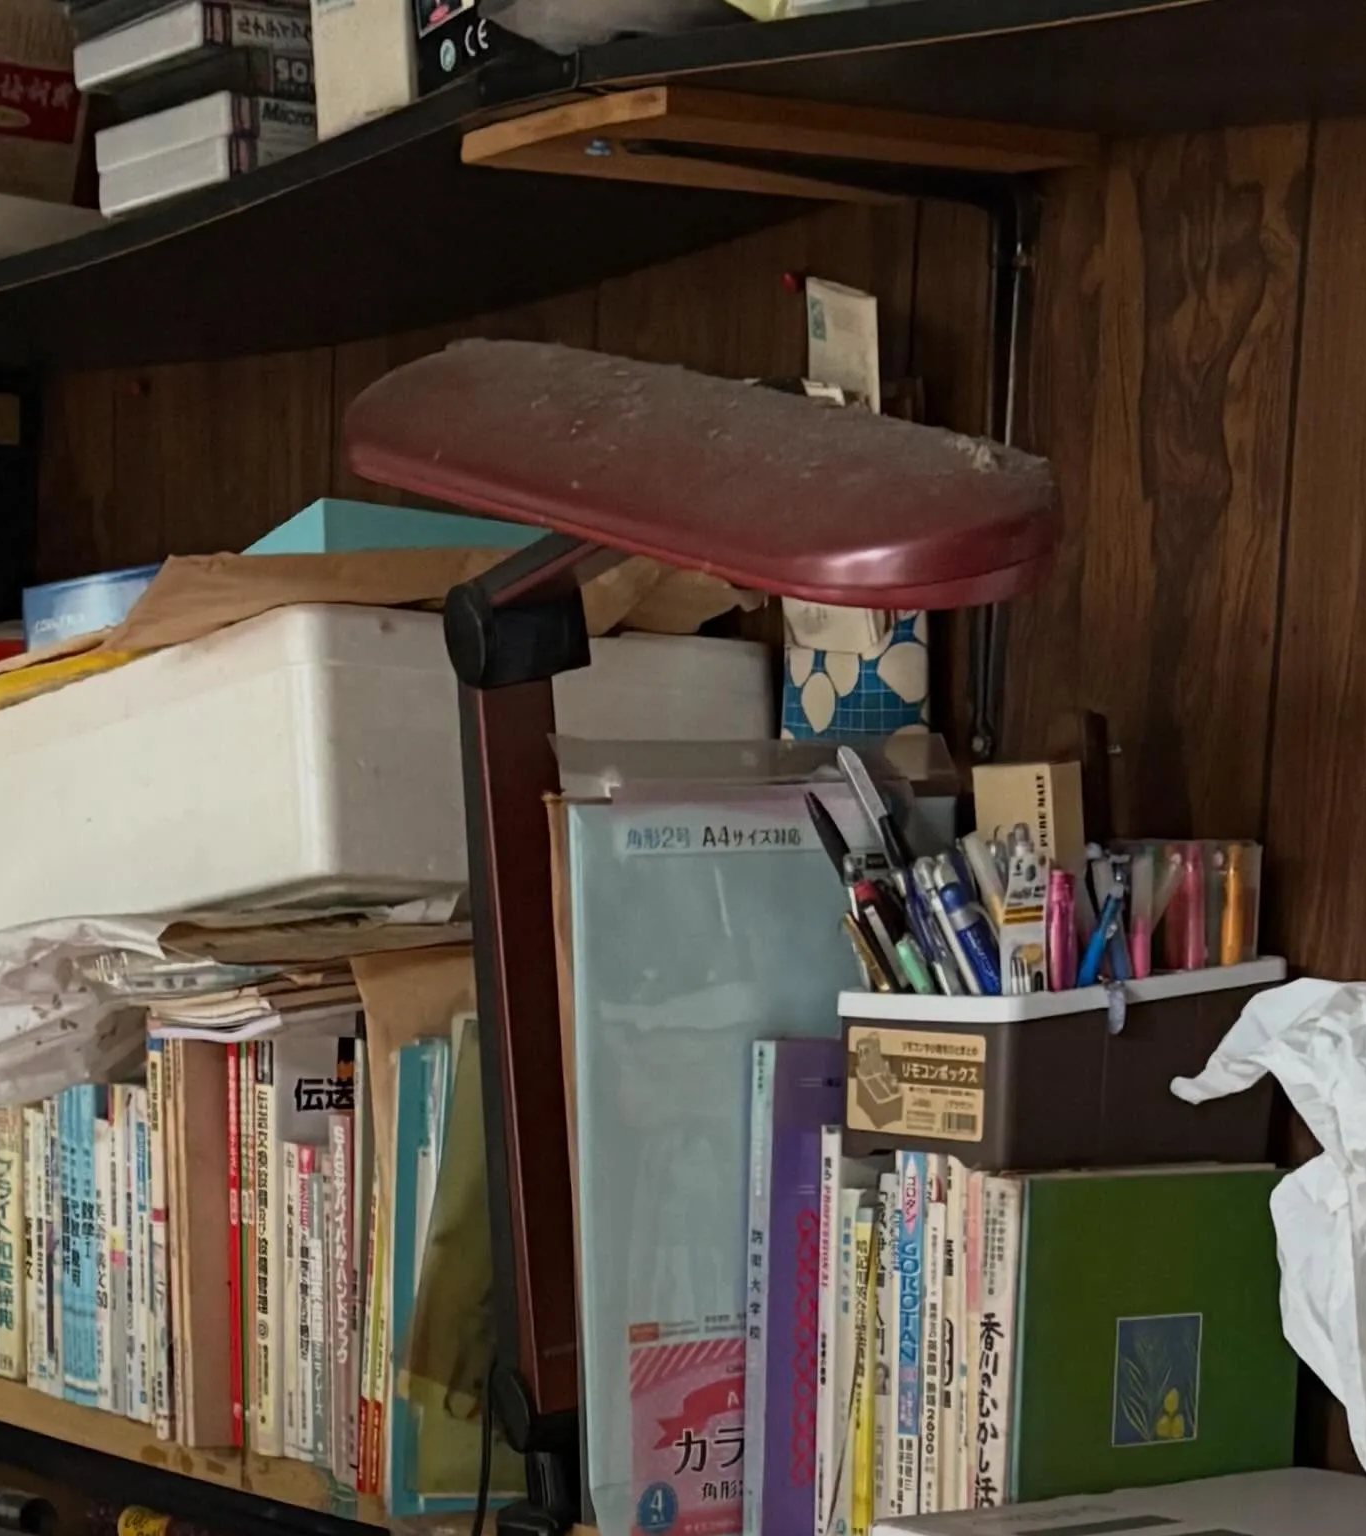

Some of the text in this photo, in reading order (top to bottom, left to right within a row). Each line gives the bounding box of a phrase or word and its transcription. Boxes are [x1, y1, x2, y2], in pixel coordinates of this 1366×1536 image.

[701, 823, 803, 848] A4サイズ対応
[1037, 811, 1049, 848] PURE
[901, 1061, 979, 1085] リモコンボックス
[294, 1077, 356, 1113] 伝送
[898, 1241, 922, 1363] GOROTAN
[974, 1311, 1006, 1509] 香川のむかし話
